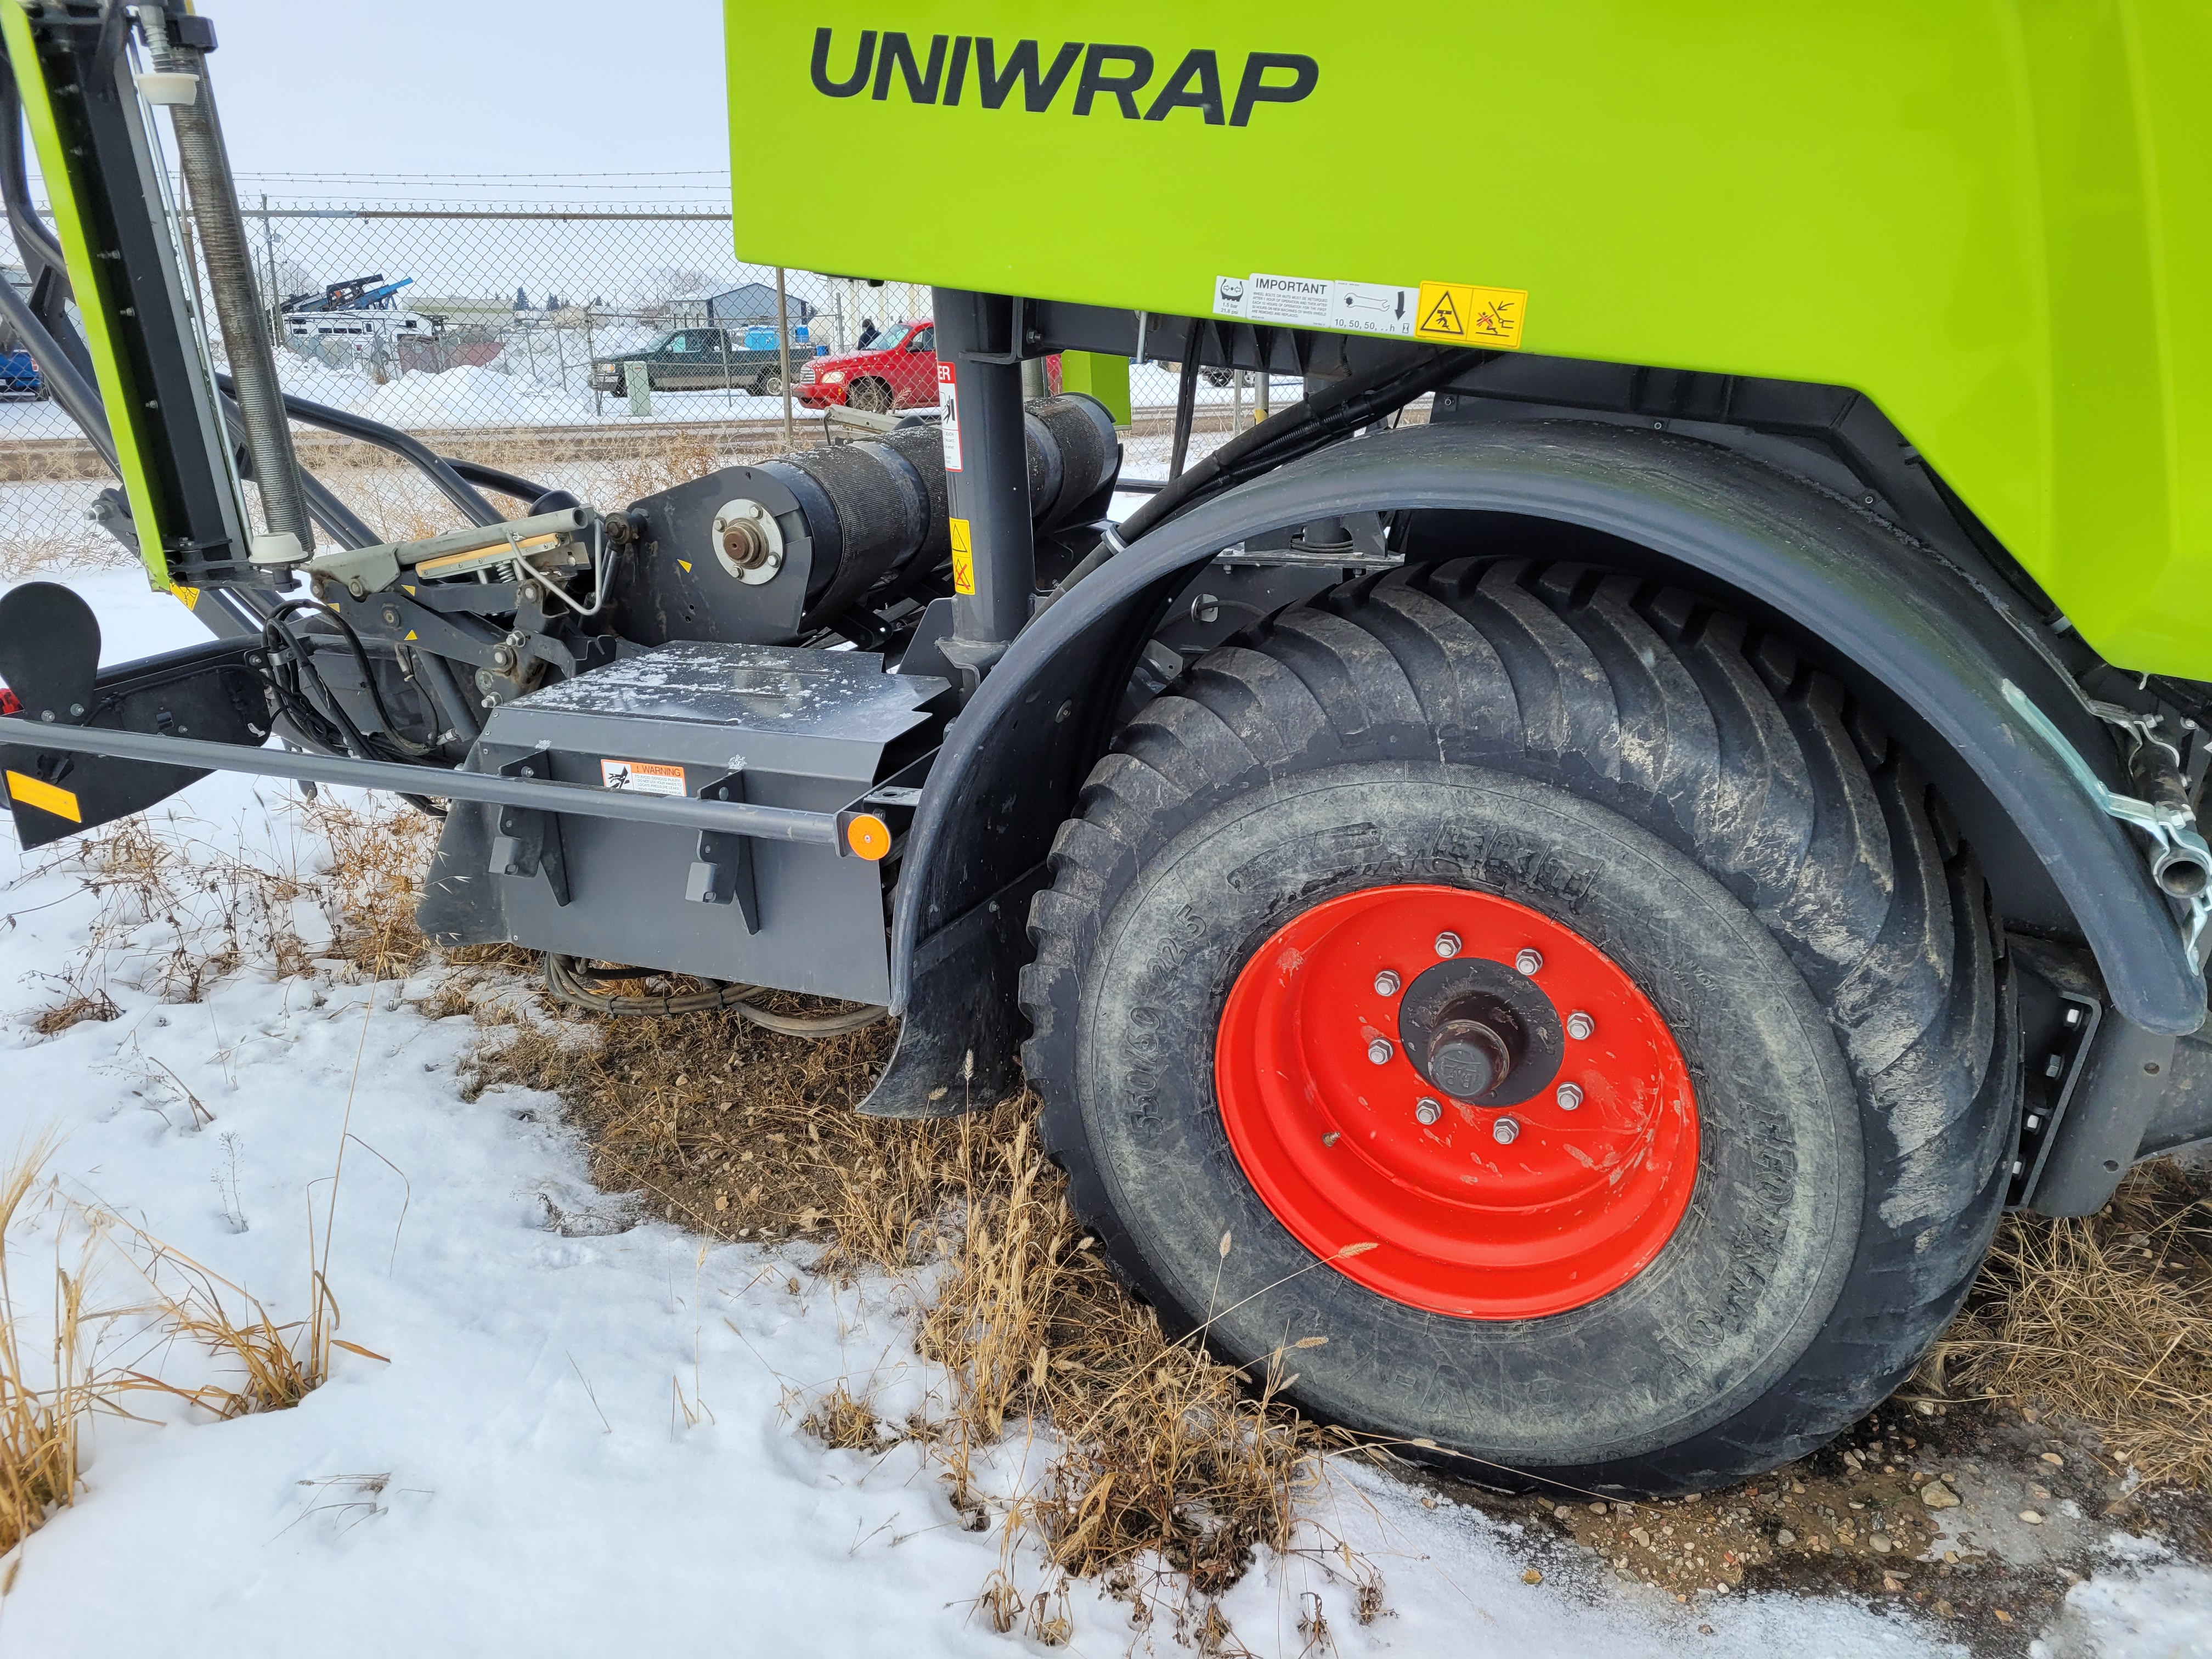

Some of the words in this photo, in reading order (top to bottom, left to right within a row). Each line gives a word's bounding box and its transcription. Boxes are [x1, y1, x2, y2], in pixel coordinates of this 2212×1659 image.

[810, 27, 1319, 127] UNIWRAP
[1255, 278, 1327, 295] IMPORTANT
[1335, 318, 1346, 328] 10,
[1349, 320, 1362, 329] 50,
[1364, 321, 1377, 331] 50,
[642, 765, 681, 777] WARNING
